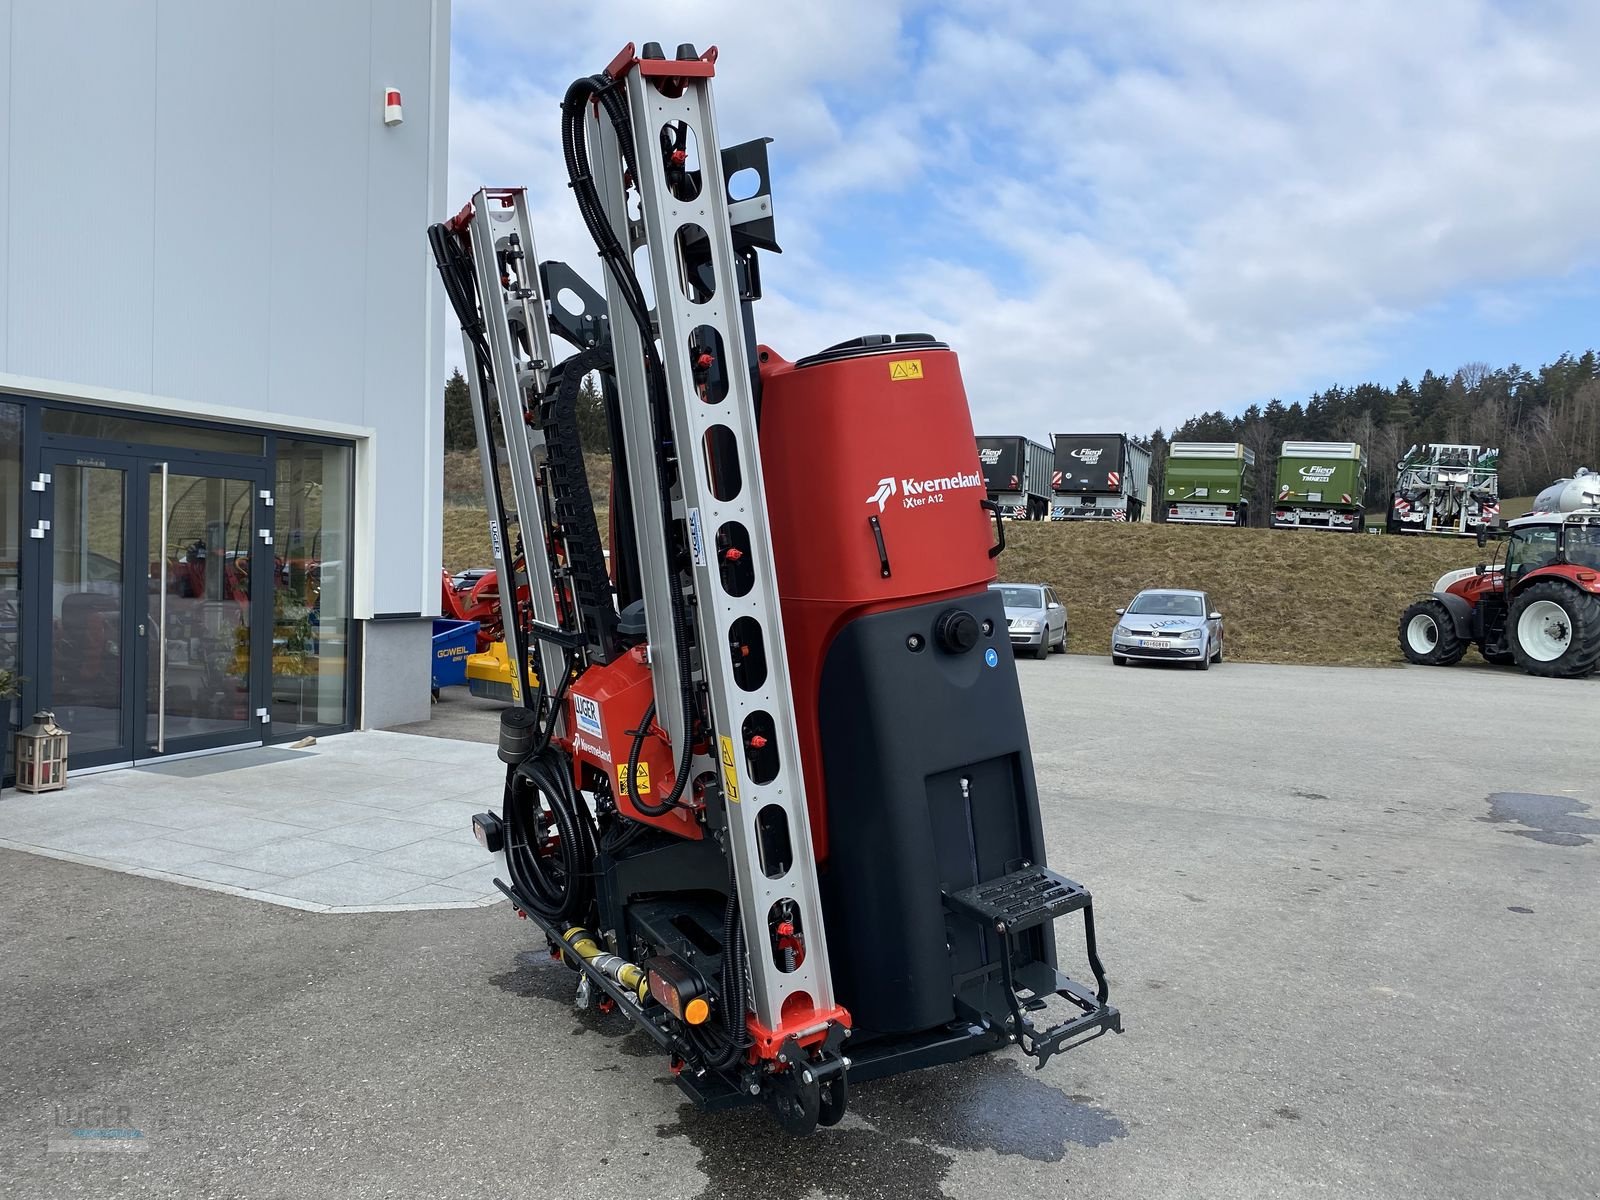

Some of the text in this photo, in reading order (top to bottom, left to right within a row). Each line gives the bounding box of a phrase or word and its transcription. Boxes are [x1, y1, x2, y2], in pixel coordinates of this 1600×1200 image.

[1080, 448, 1103, 458] Fliegl
[1310, 465, 1336, 474] Fliegl
[901, 470, 981, 496] Kverneland
[902, 493, 944, 509] iXter A12
[491, 521, 500, 553] LUGER
[689, 515, 700, 565] LUGER
[1150, 619, 1188, 629] LUGER
[574, 695, 597, 721] LUGER
[580, 738, 612, 763] Kverneland
